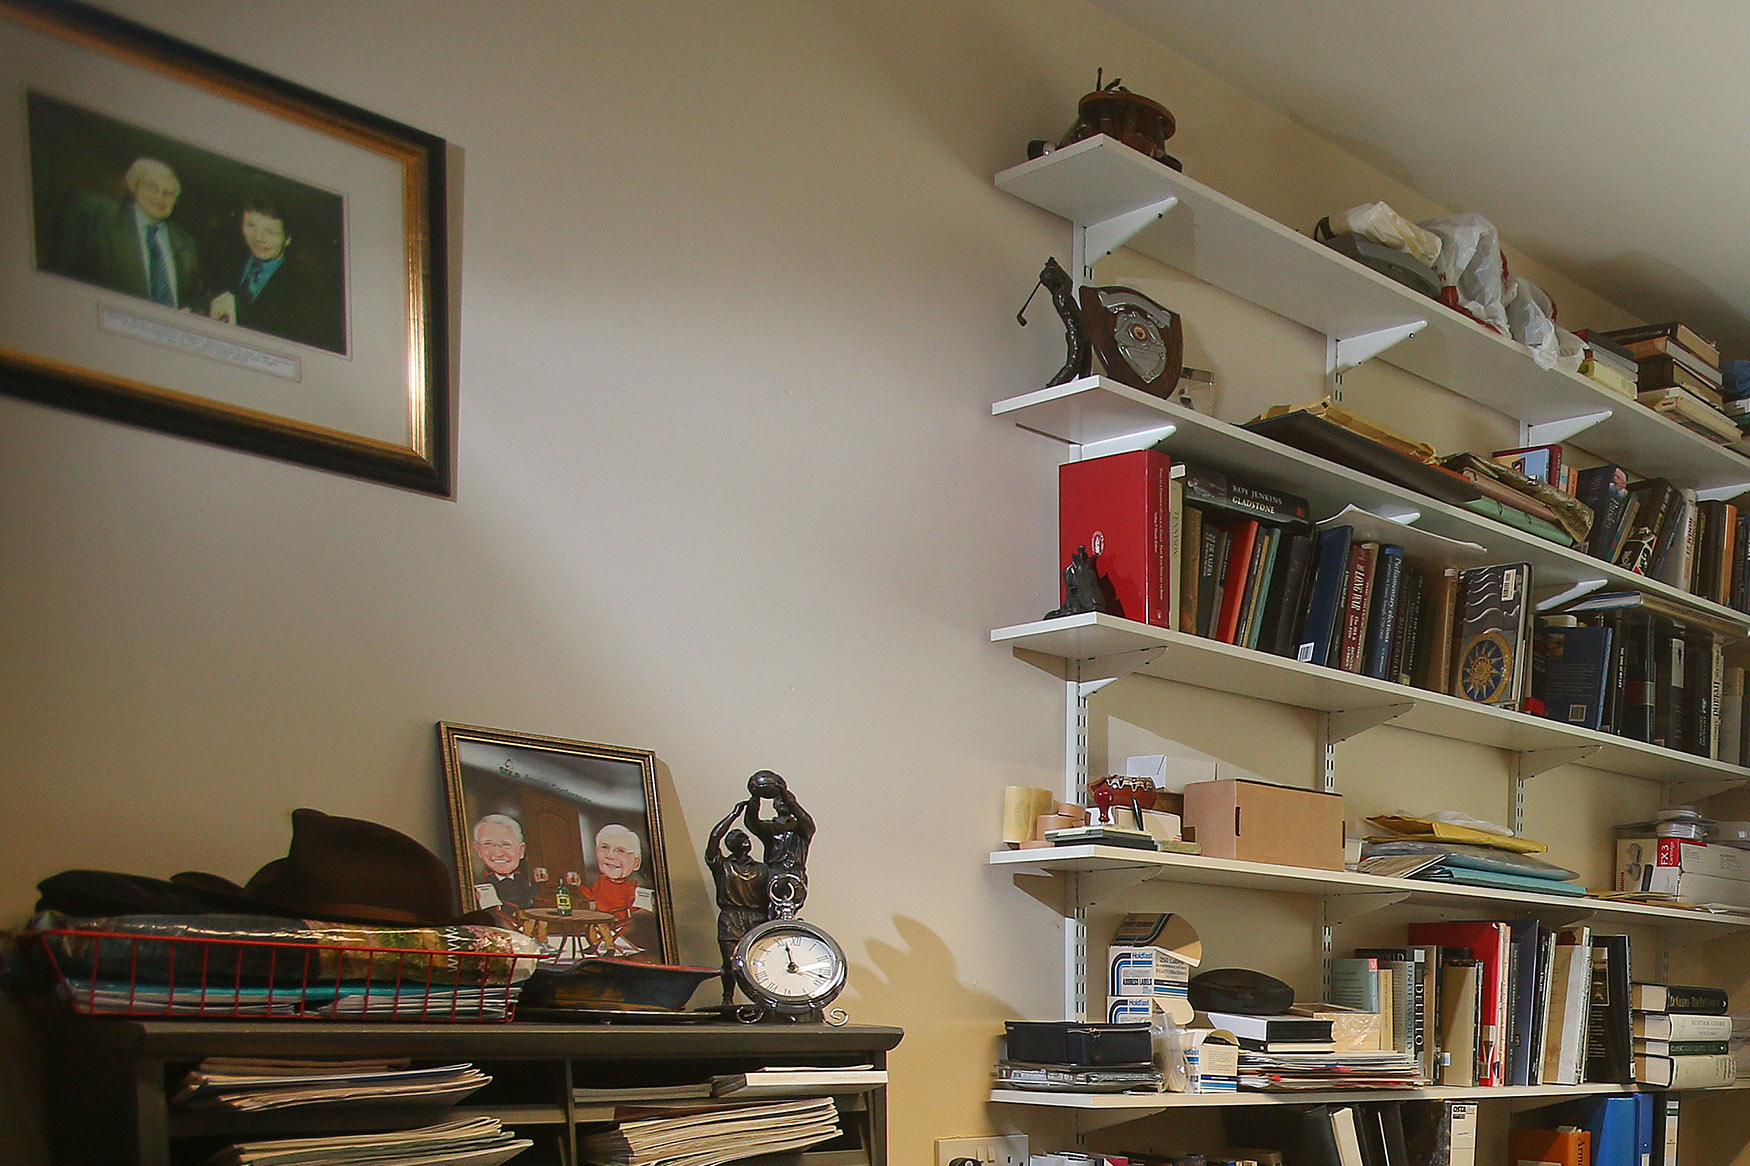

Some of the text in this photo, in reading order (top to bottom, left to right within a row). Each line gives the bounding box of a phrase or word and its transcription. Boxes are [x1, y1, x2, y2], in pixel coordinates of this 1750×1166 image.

[1232, 484, 1283, 504] ROY JENKINS
[1232, 497, 1275, 514] GLADSTONE
[1352, 569, 1364, 594] LONG
[1352, 592, 1363, 612] WAR
[1385, 556, 1401, 643] Parliamentary elections
[1660, 852, 1668, 865] FX
[1406, 965, 1414, 1050] UNDERWORLD
